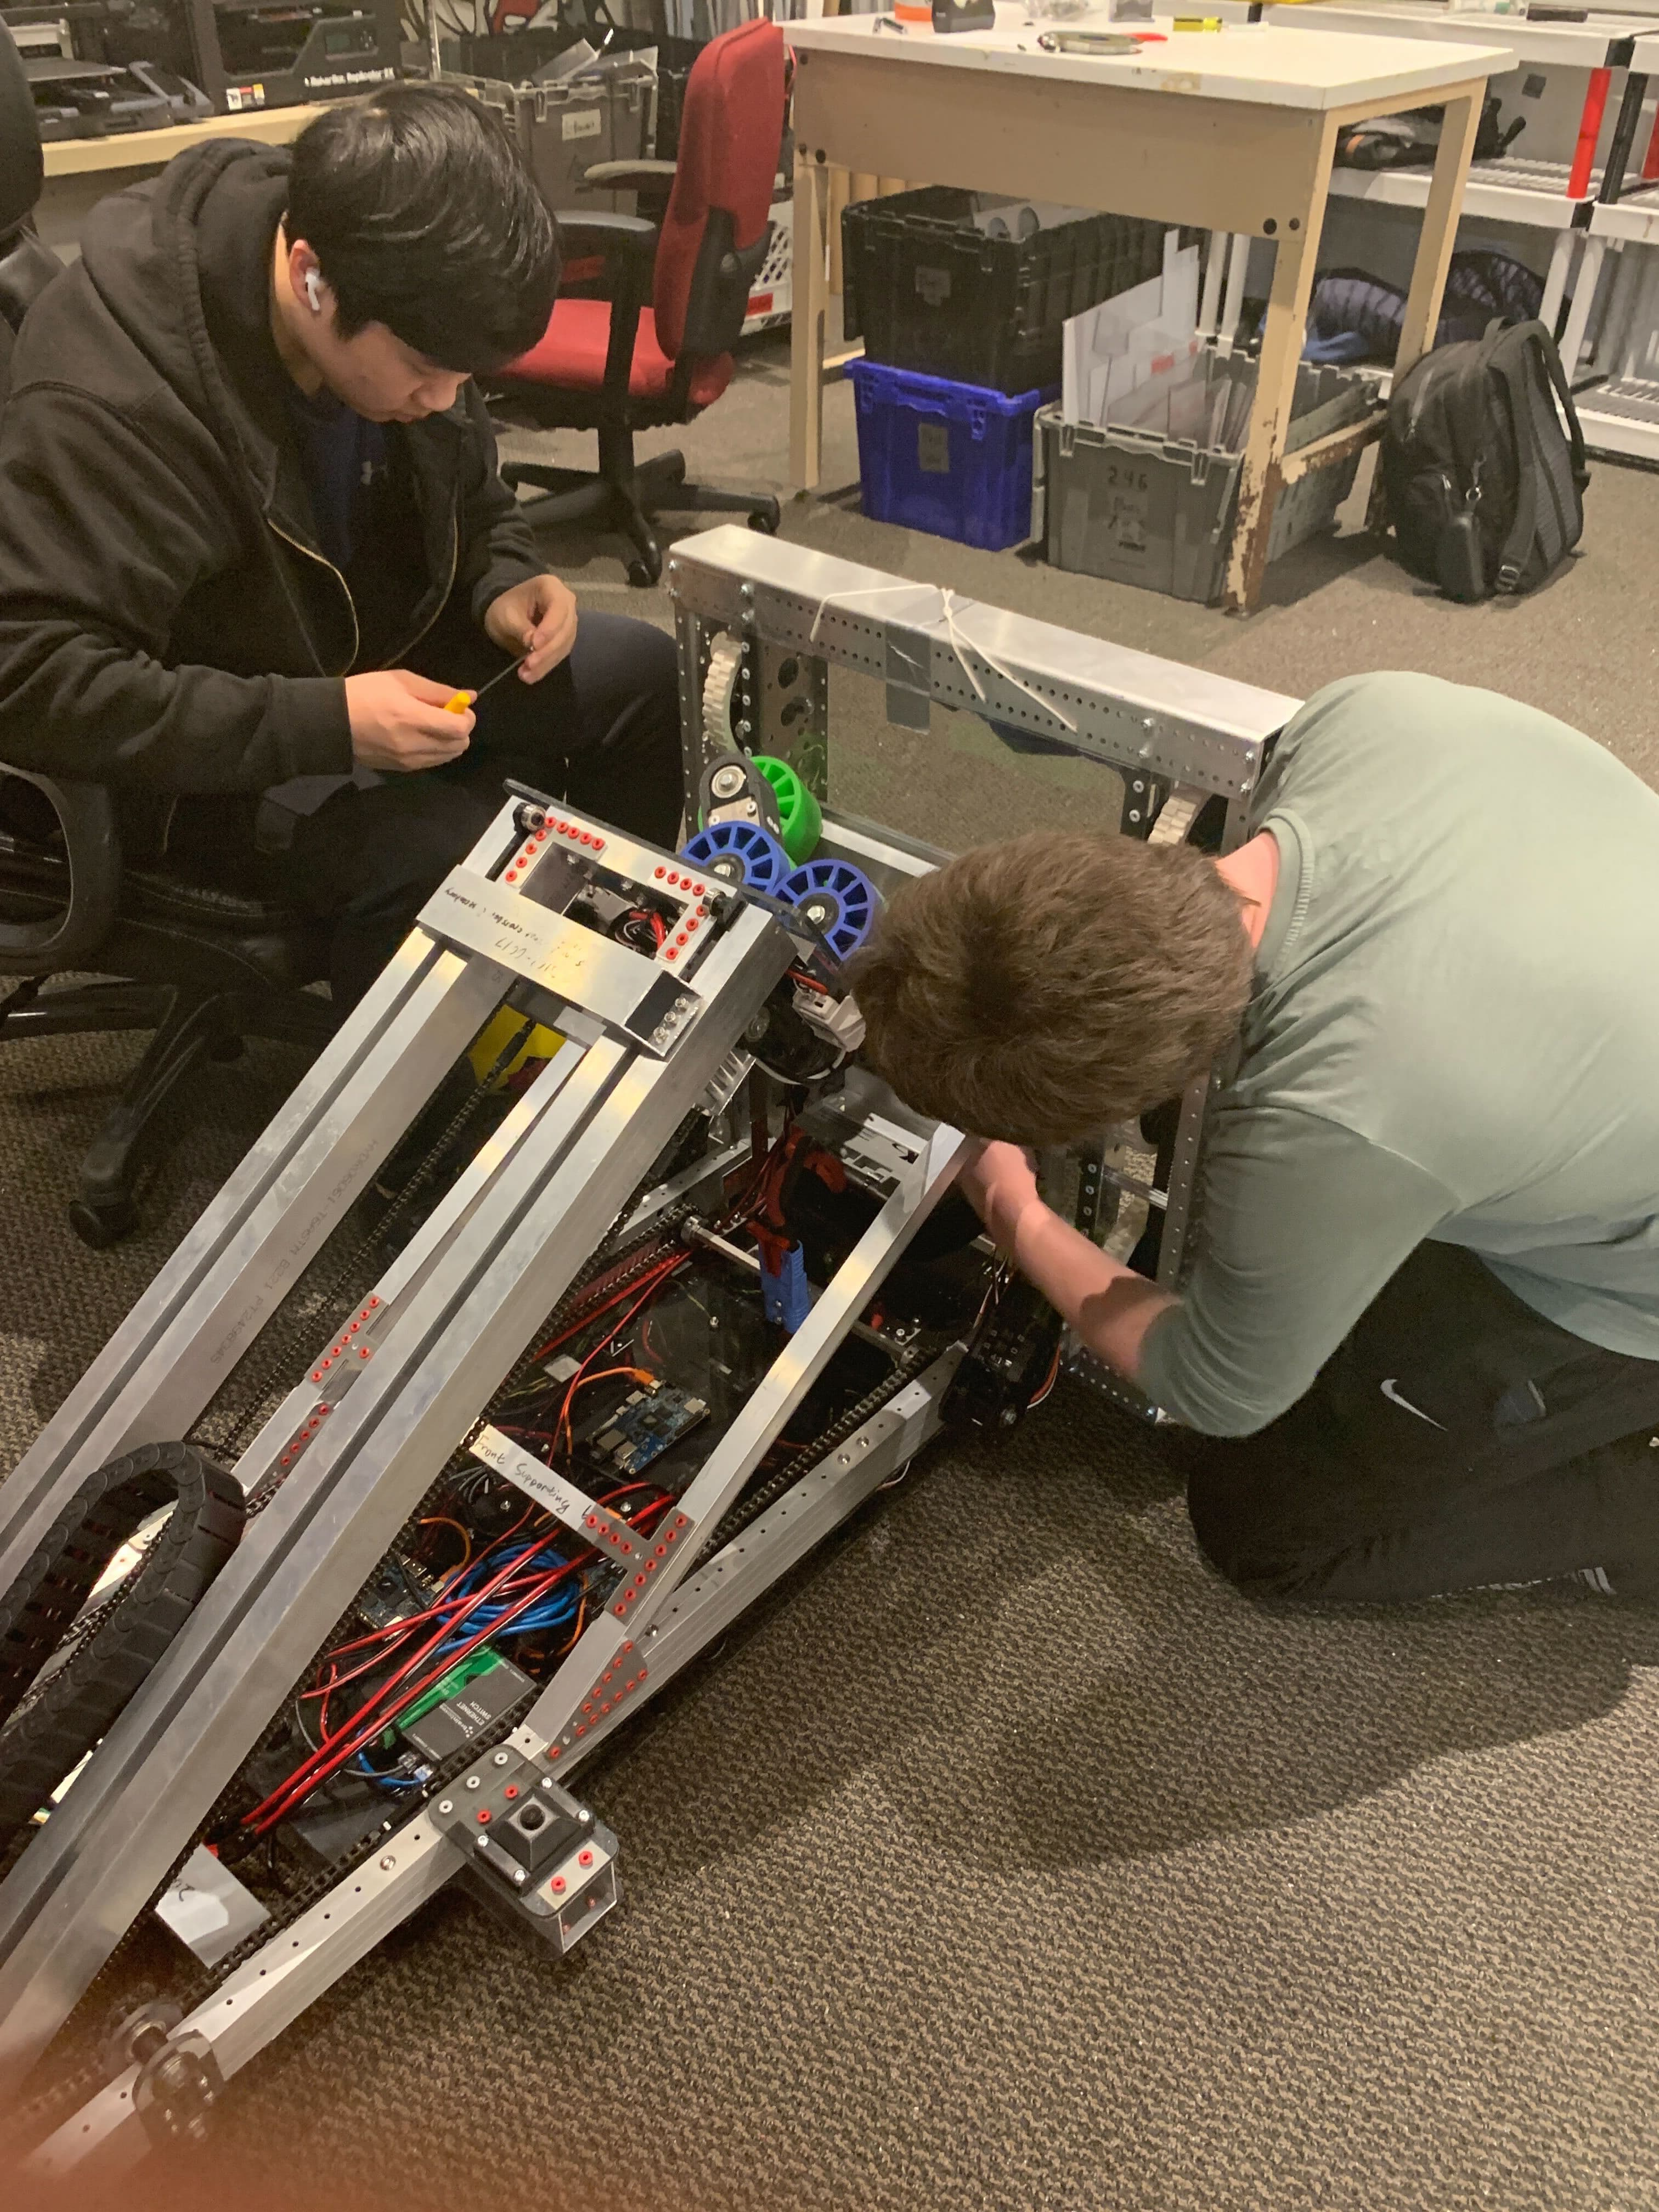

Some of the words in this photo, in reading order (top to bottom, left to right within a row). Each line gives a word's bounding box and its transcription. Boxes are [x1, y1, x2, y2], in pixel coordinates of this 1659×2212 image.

[474, 1434, 506, 1465] Front
[514, 1462, 571, 1514] Supporting
[456, 1700, 485, 1726] ETHERNET
[469, 1701, 492, 1720] SWITCH
